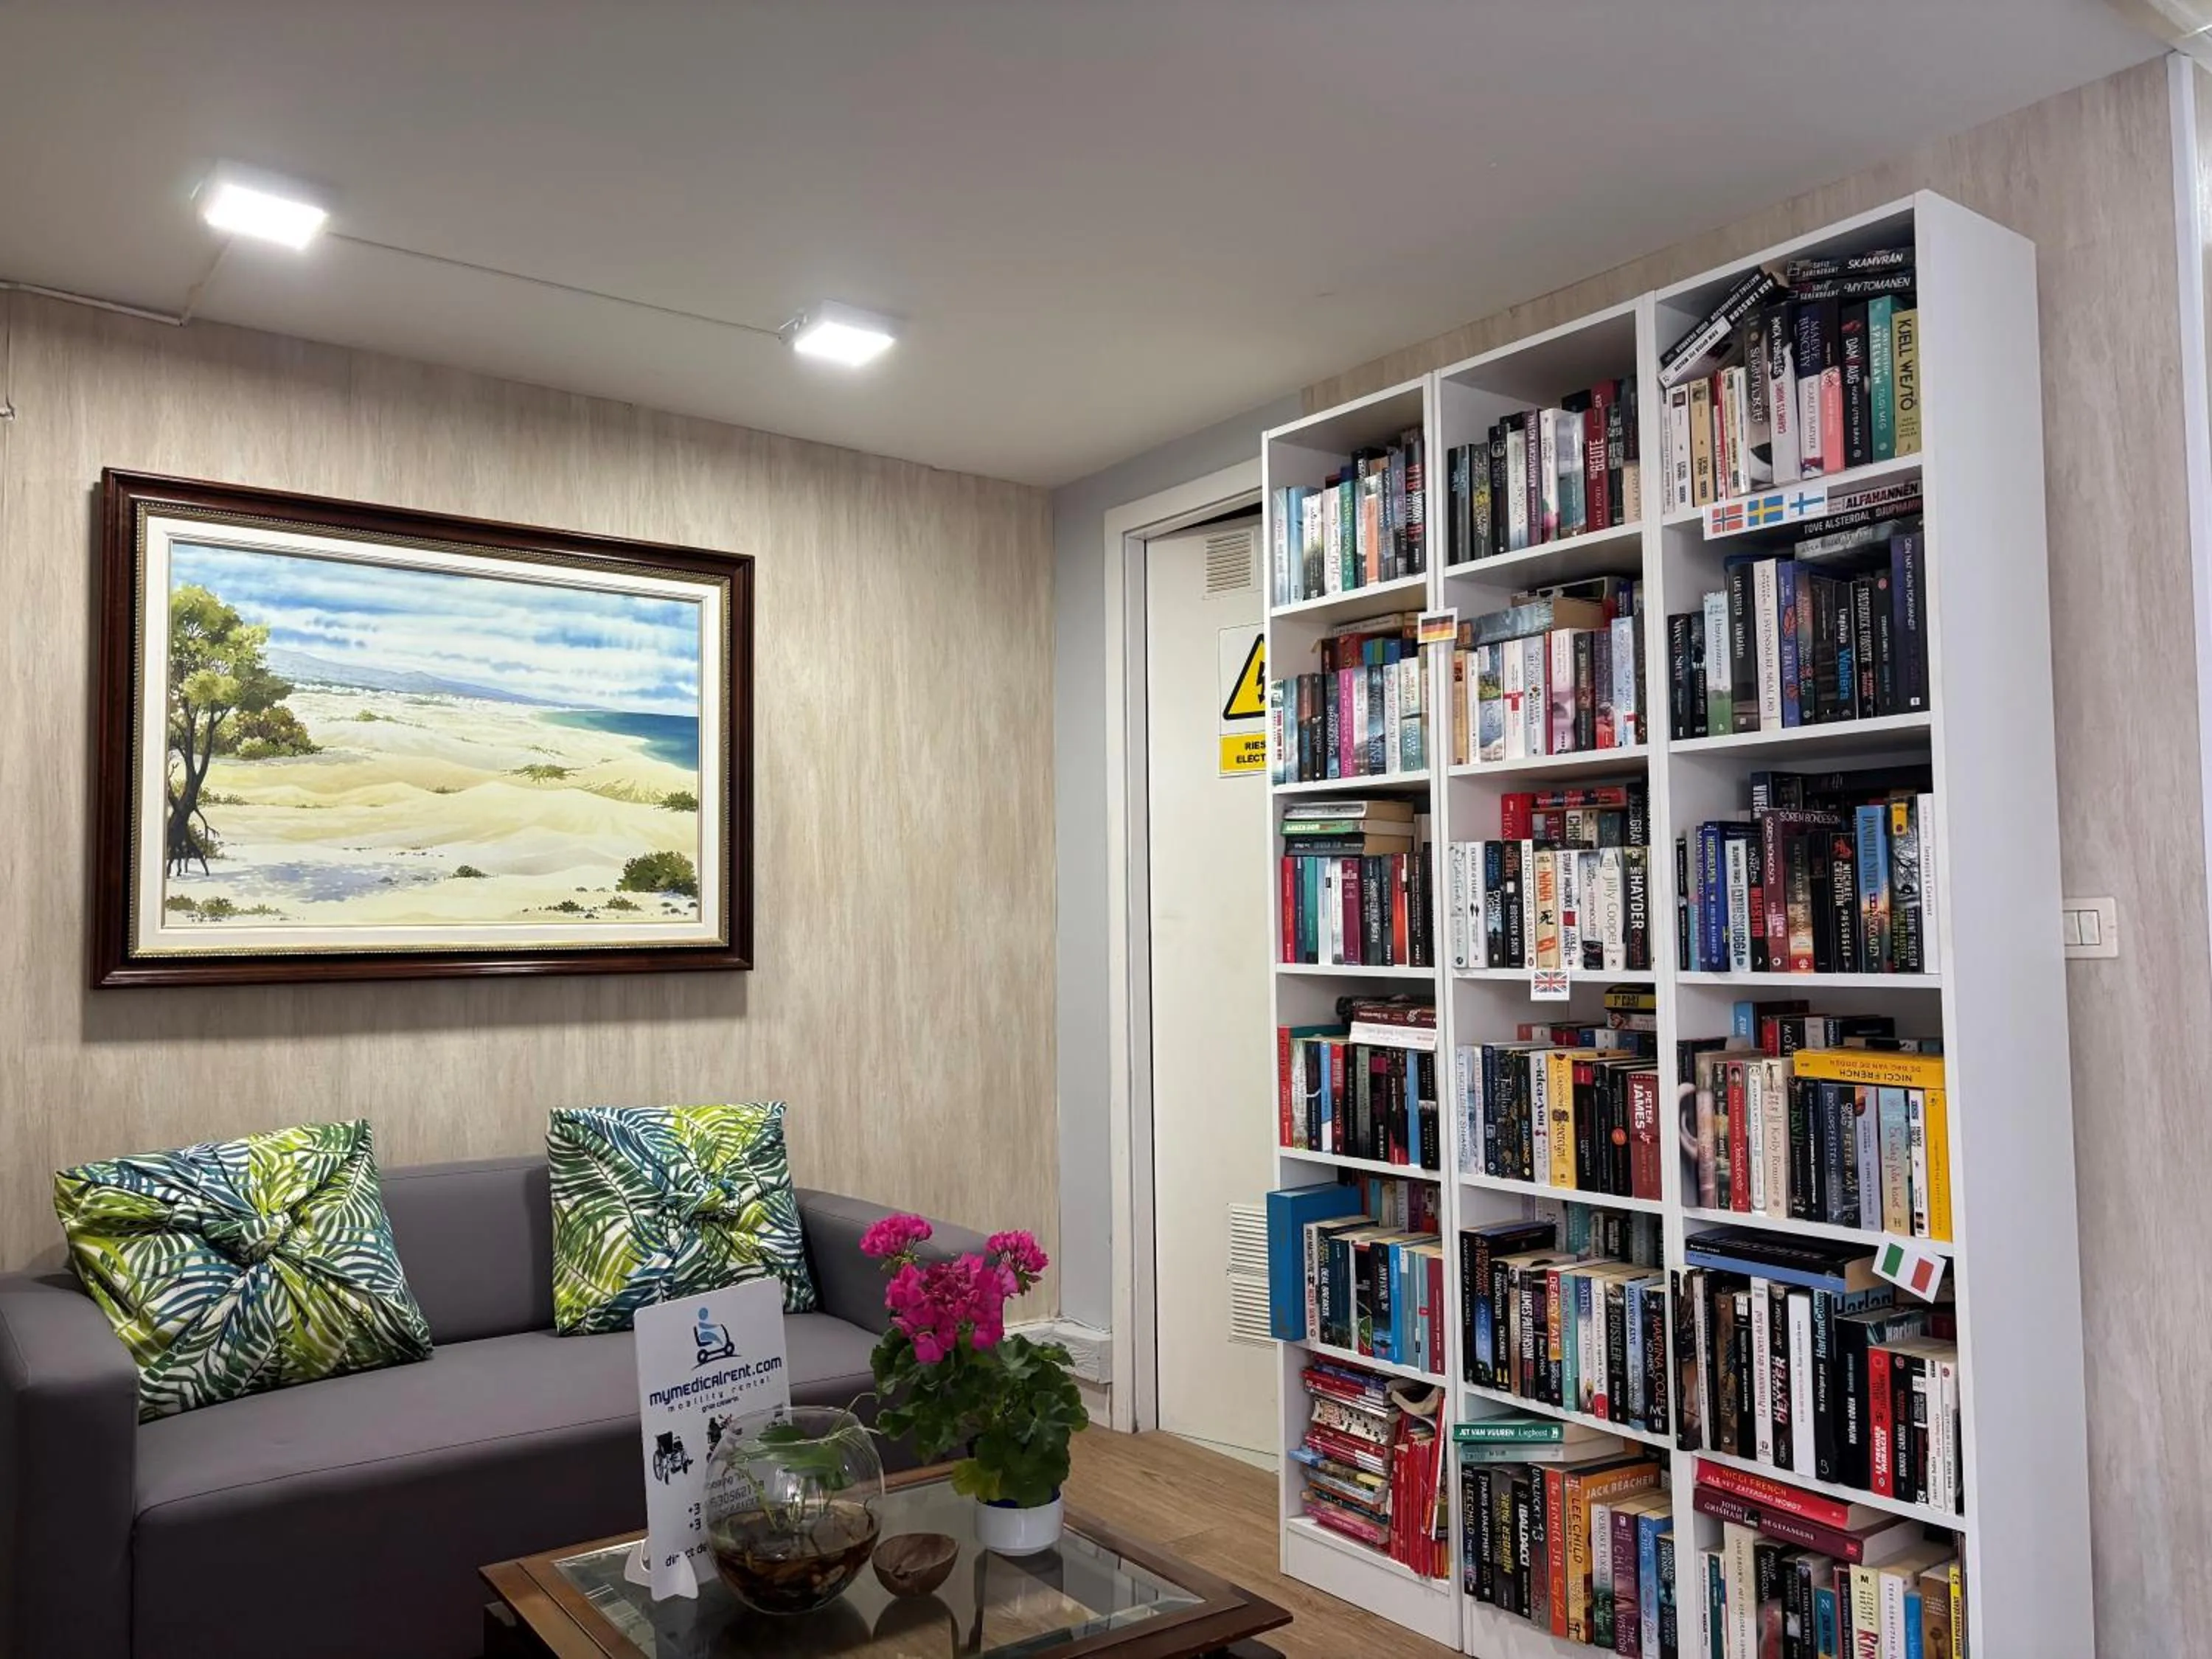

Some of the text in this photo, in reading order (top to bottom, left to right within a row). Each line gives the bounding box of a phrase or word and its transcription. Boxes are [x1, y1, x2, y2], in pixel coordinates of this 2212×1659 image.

[1897, 319, 1912, 357] KJELL
[1846, 483, 1919, 509] ALFAHANNEN
[1630, 819, 1643, 846] GRAY
[1863, 815, 1879, 890] DANIELLE STEEL
[1630, 875, 1644, 929] HAYDER
[1833, 860, 1844, 907] CRICHTON
[1842, 863, 1851, 902] MICHAEL
[1602, 876, 1620, 945] Jilly Cooper
[1839, 1069, 1880, 1080] FRENCH
[1633, 1083, 1646, 1130] JAMES
[1644, 1091, 1652, 1124] PETER
[1770, 1127, 1781, 1152] Kelly
[1843, 1133, 1854, 1192] PETER MAY
[1494, 1272, 1504, 1319] blackman
[1549, 1276, 1559, 1350] DEADLY FATE
[1521, 1290, 1534, 1360] JAMES PATTERSON
[1610, 1315, 1621, 1361] CUSSLER
[1815, 1321, 1826, 1358] Harlan
[648, 1356, 783, 1408] mymedicalrent.com
[1653, 1314, 1665, 1407] MARTINA COLE
[667, 1375, 772, 1413] mobility rental
[1774, 1355, 1789, 1425] DEXTER
[1466, 1483, 1475, 1534] LEE CHILD
[1480, 1481, 1489, 1562] PARIS APARTMENT
[1531, 1469, 1544, 1542] UNLUCKY 13
[1519, 1511, 1529, 1567] BALDACCI
[1571, 1498, 1583, 1564] LEE CHILD
[665, 1551, 695, 1568] dirct
[1617, 1613, 1627, 1652] VISITOR
[1627, 1625, 1635, 1644] THE
